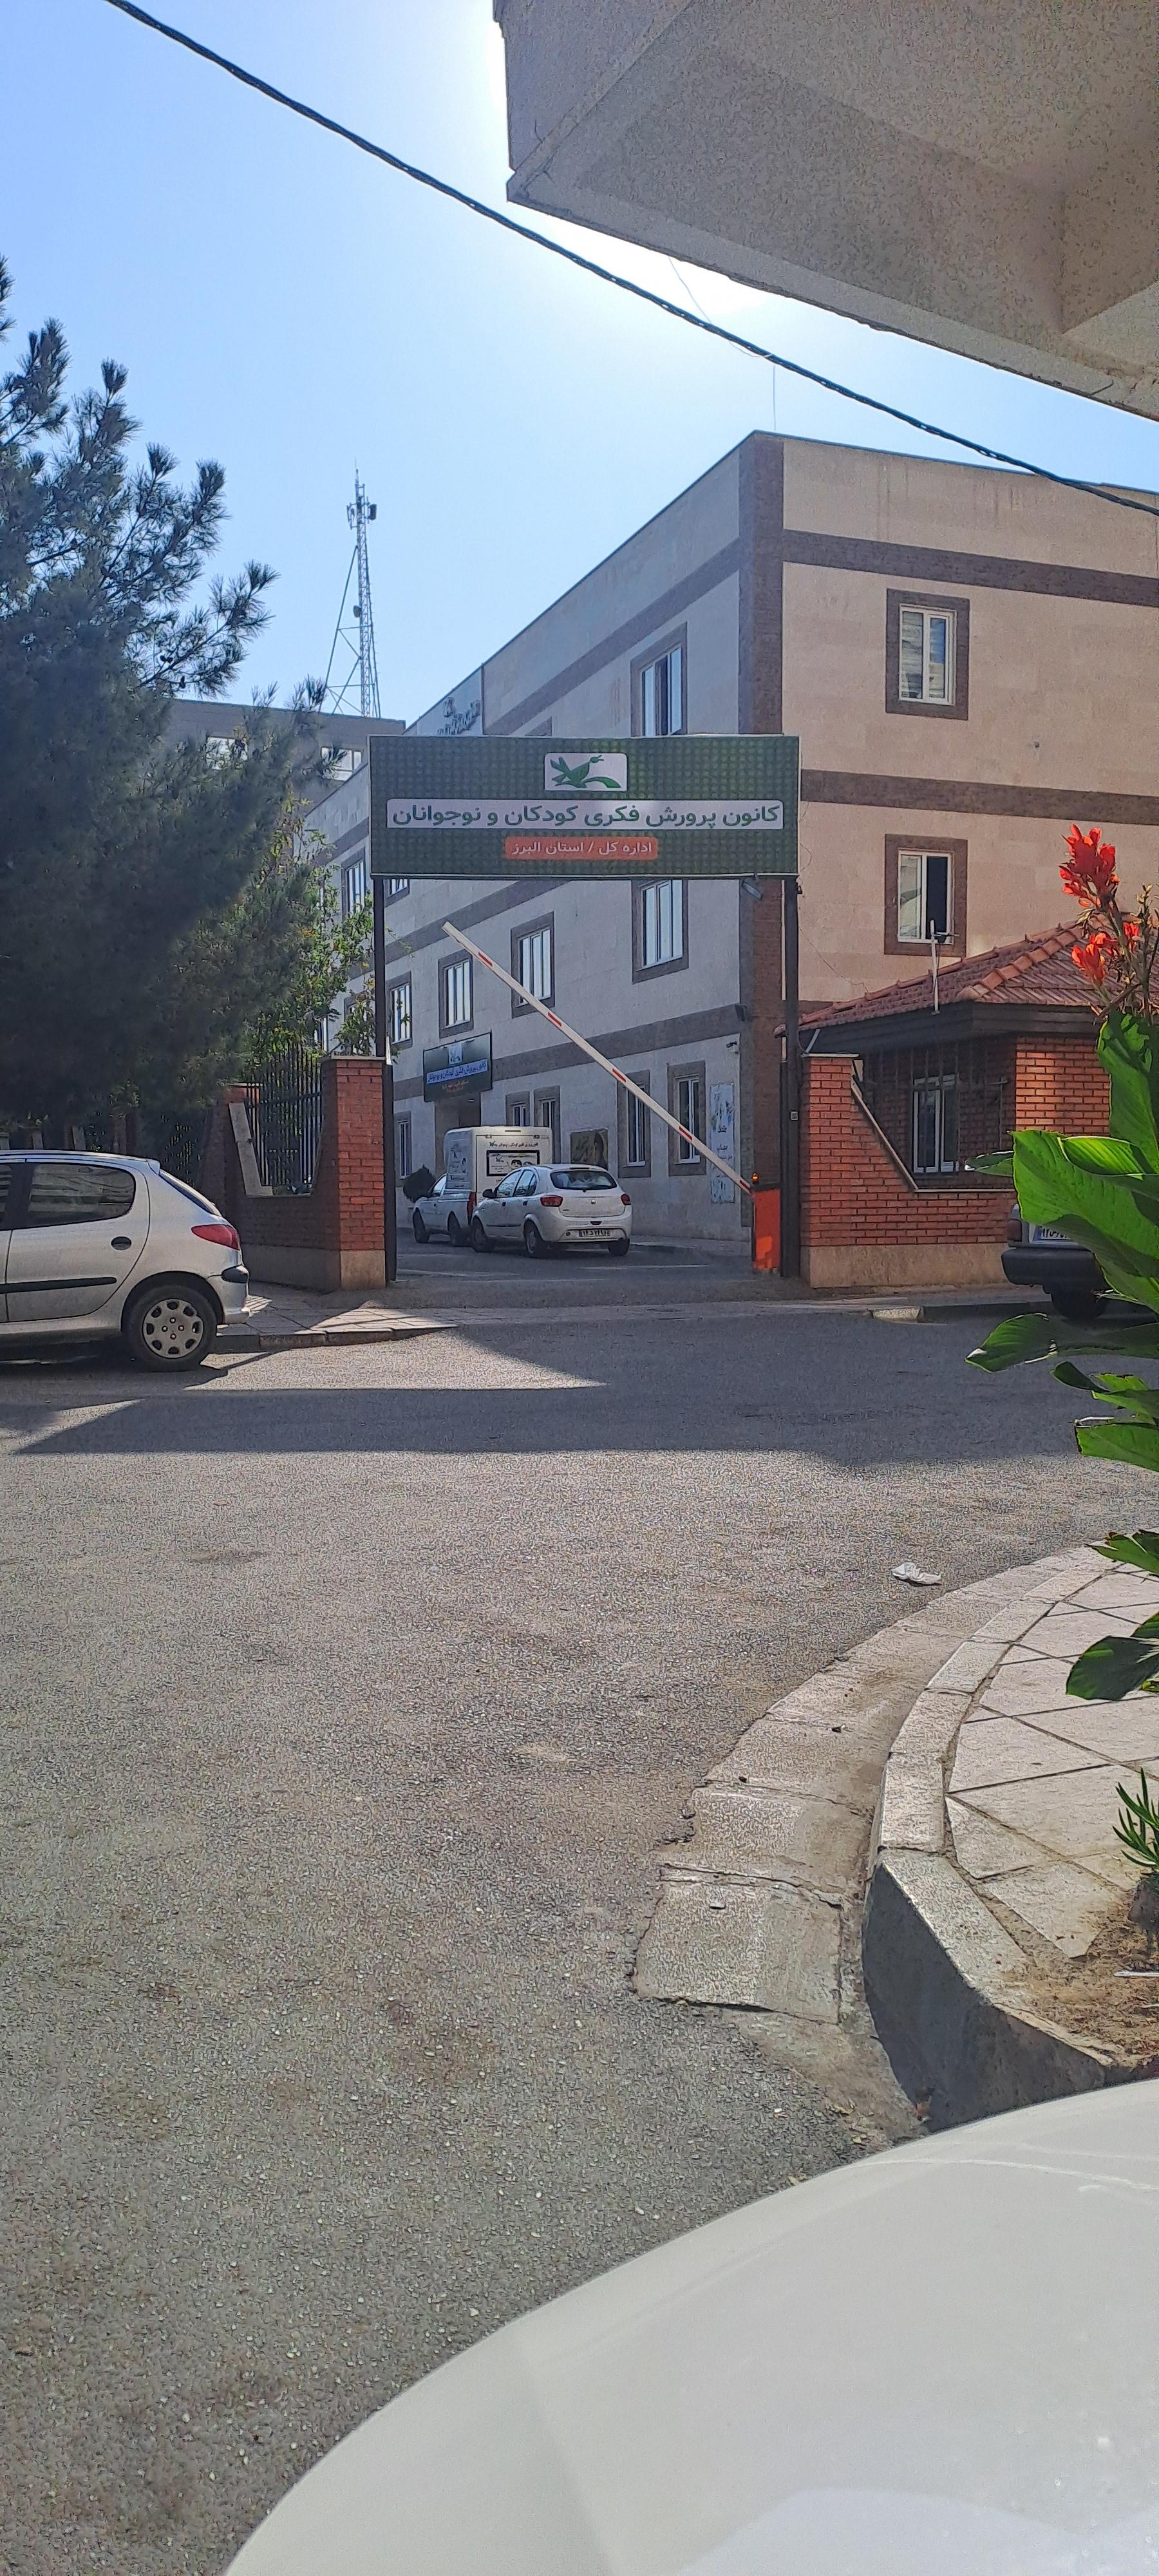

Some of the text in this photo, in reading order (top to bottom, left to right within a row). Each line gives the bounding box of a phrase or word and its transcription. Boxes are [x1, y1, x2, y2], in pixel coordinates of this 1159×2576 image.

[393, 804, 780, 829] کانون پرورش فکری کودکان و نوجوانان
[512, 840, 652, 855] اداره کل / استان البرز
